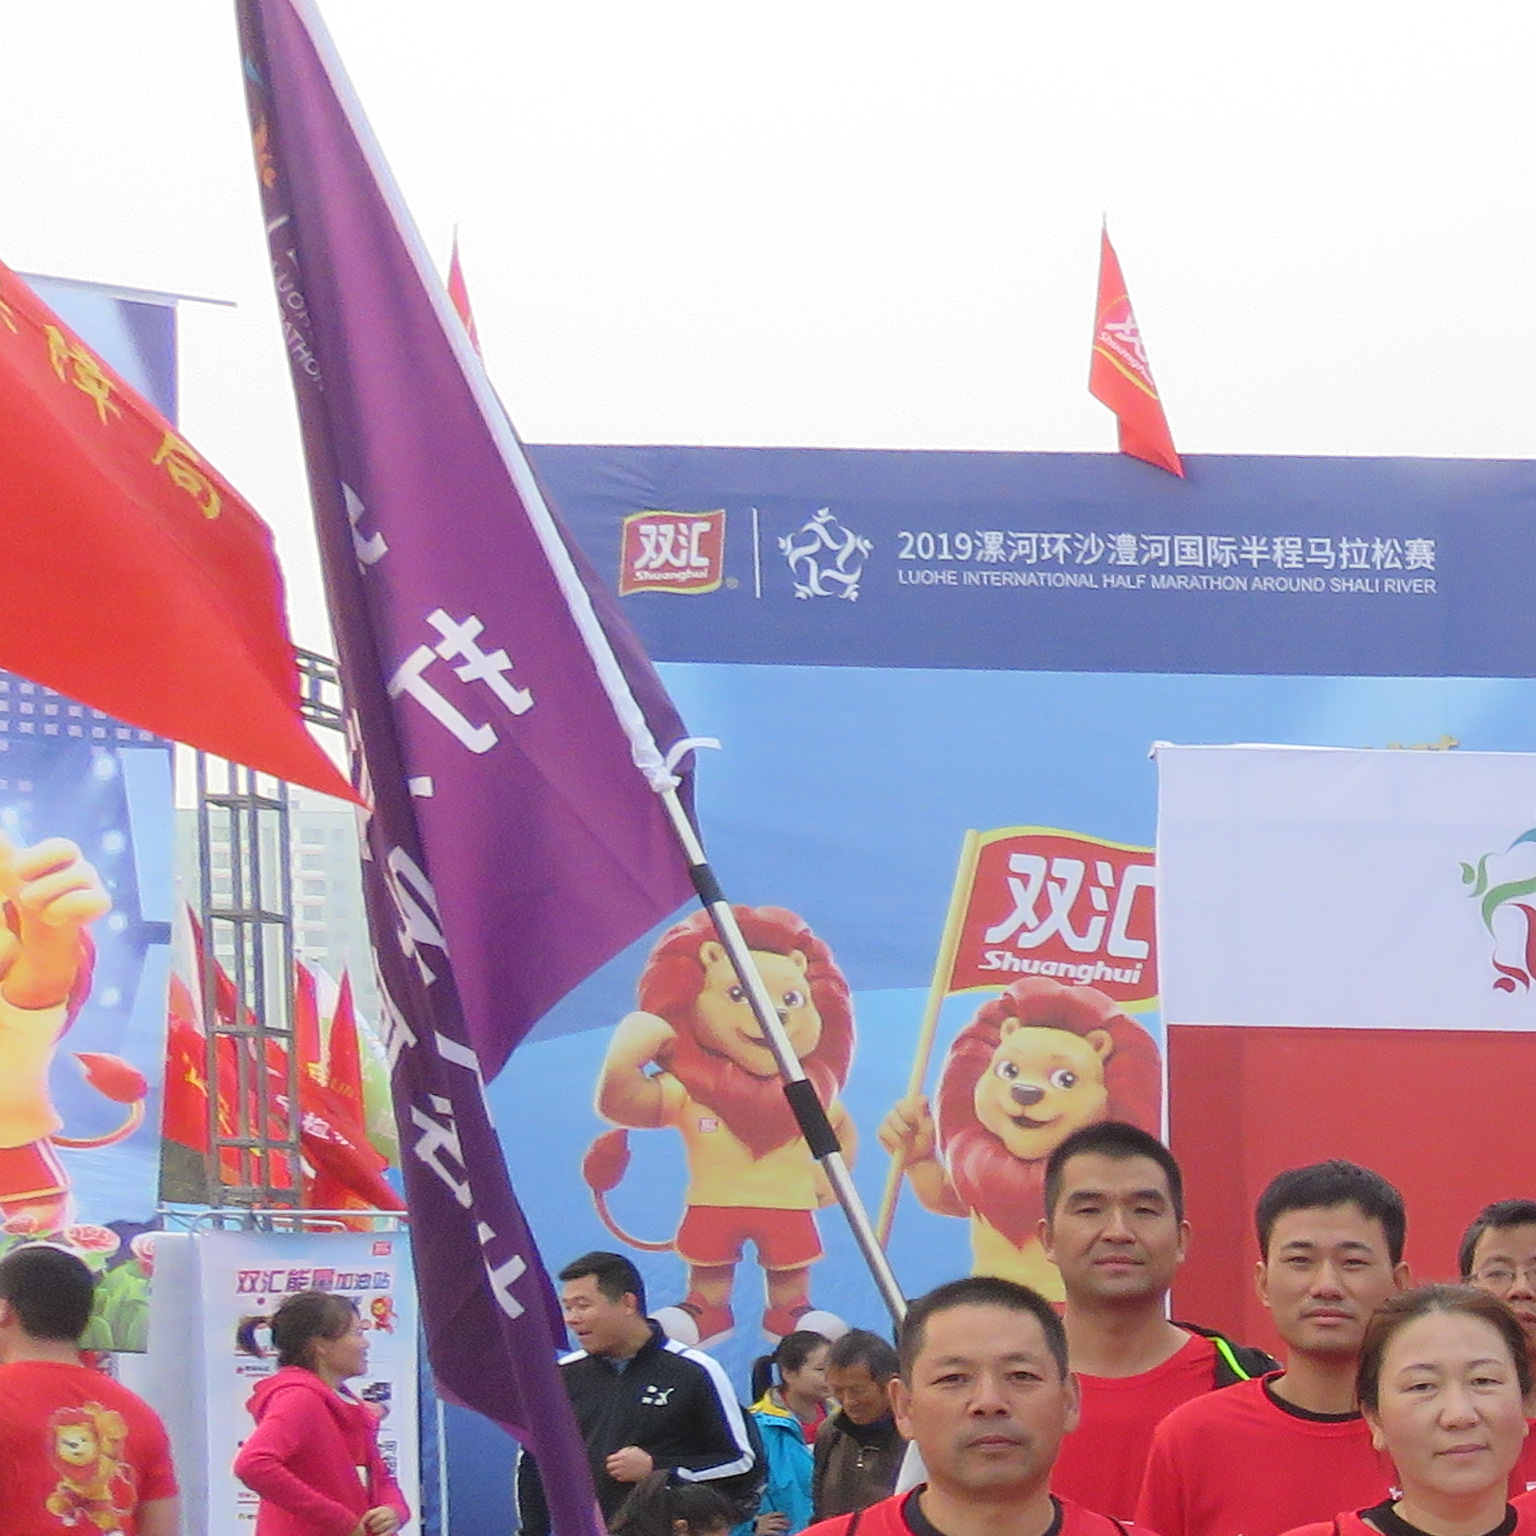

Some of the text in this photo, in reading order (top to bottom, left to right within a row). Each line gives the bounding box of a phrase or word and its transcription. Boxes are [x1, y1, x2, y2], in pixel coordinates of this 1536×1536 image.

[634, 522, 712, 568] 双汇
[897, 530, 1437, 572] 2019漯河环沙澧河国际半程马拉松赛
[898, 568, 1438, 595] LUOHE INTERNATIONAL HALF MARATHON AROUND SHALI RIVER
[984, 853, 1157, 960] 双汇
[977, 950, 1142, 986] Shuanghui
